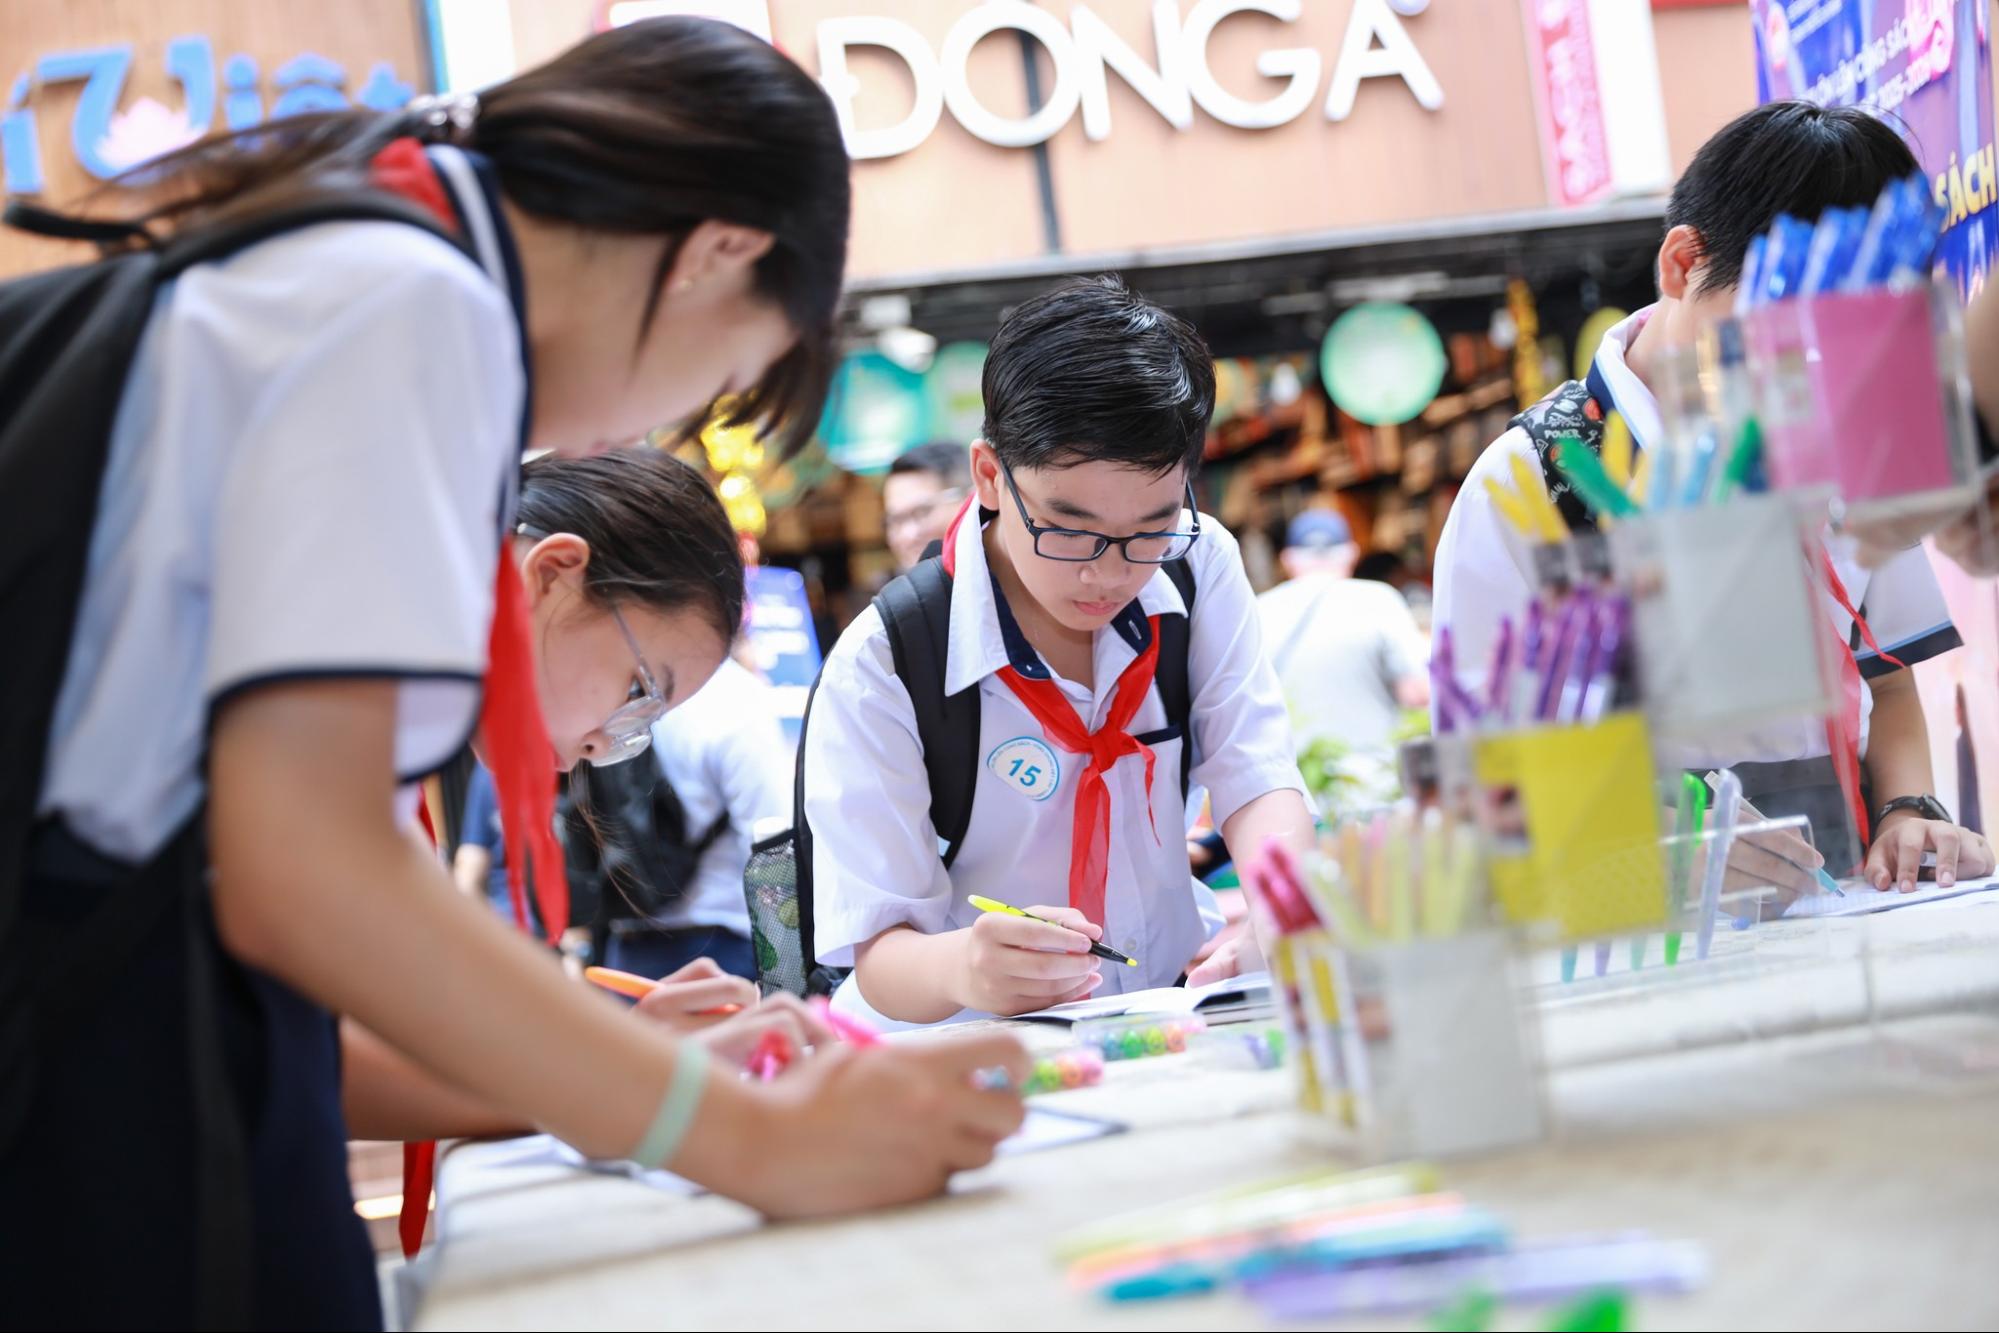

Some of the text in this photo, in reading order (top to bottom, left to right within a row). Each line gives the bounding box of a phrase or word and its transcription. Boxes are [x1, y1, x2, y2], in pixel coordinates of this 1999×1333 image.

[1935, 142, 1998, 234] SÁCH
[1543, 429, 1582, 439] POWER
[1008, 758, 1042, 787] 15
